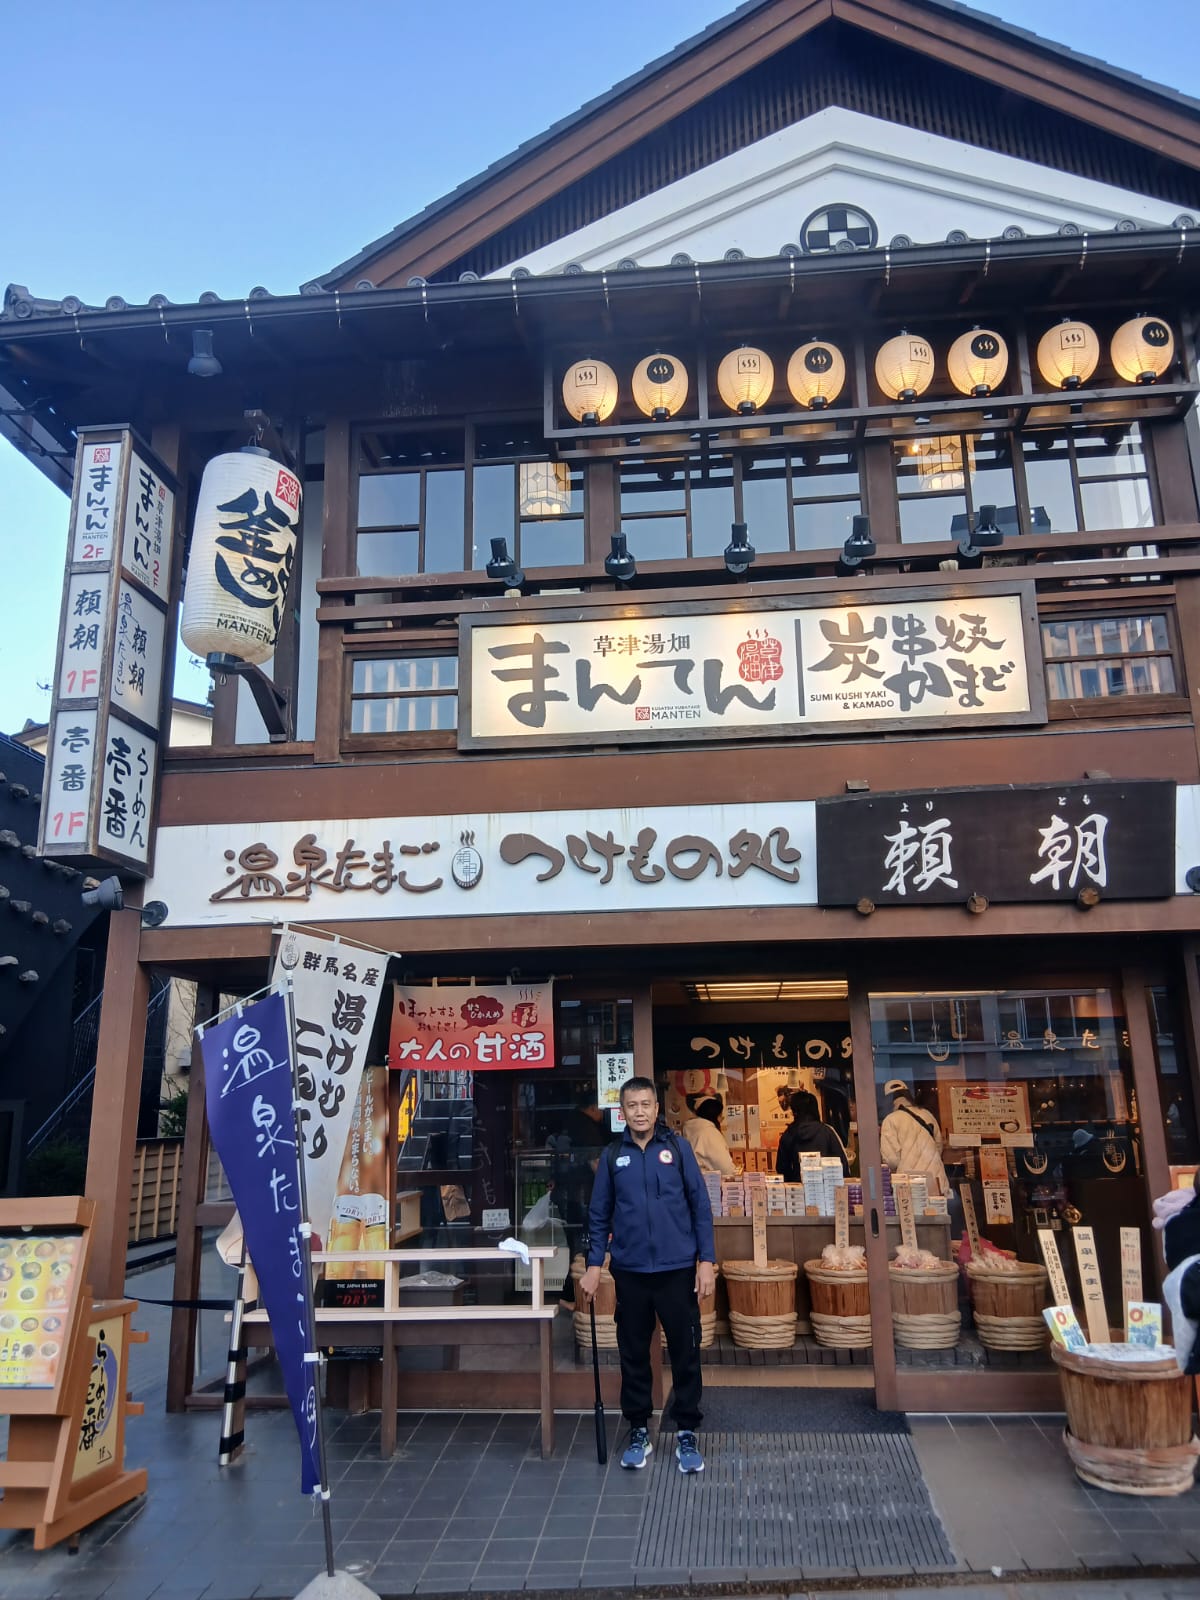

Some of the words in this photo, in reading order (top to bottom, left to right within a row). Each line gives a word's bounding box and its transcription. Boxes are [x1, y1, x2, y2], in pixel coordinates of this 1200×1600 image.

[86, 465, 113, 531] まんてん
[134, 467, 156, 570] まんてん
[82, 544, 104, 559] 2F
[152, 560, 160, 588] 2F
[217, 617, 271, 645] MANTEN
[593, 633, 691, 657] 草津湯畑
[67, 669, 98, 694] 1F
[488, 631, 777, 728] まんてん
[883, 658, 1016, 712] かまど
[810, 694, 833, 702] SUMI
[835, 692, 863, 700] KUSHI
[865, 690, 887, 698] YAKI
[852, 700, 895, 709] KAMADO
[651, 710, 701, 720] MANTEN
[58, 726, 90, 791] 壱番
[104, 737, 131, 839] 壱番
[130, 747, 149, 849] らーめん
[901, 802, 935, 813] より
[1058, 795, 1091, 806] とも
[53, 812, 86, 837] 1F
[209, 834, 443, 902] 温泉たまご
[500, 827, 801, 884] つけもの処
[302, 950, 381, 988] 群馬名産
[399, 998, 456, 1018] ほっとする
[400, 1031, 546, 1063] 大人の甘酒
[307, 988, 368, 1160] 湯けむり
